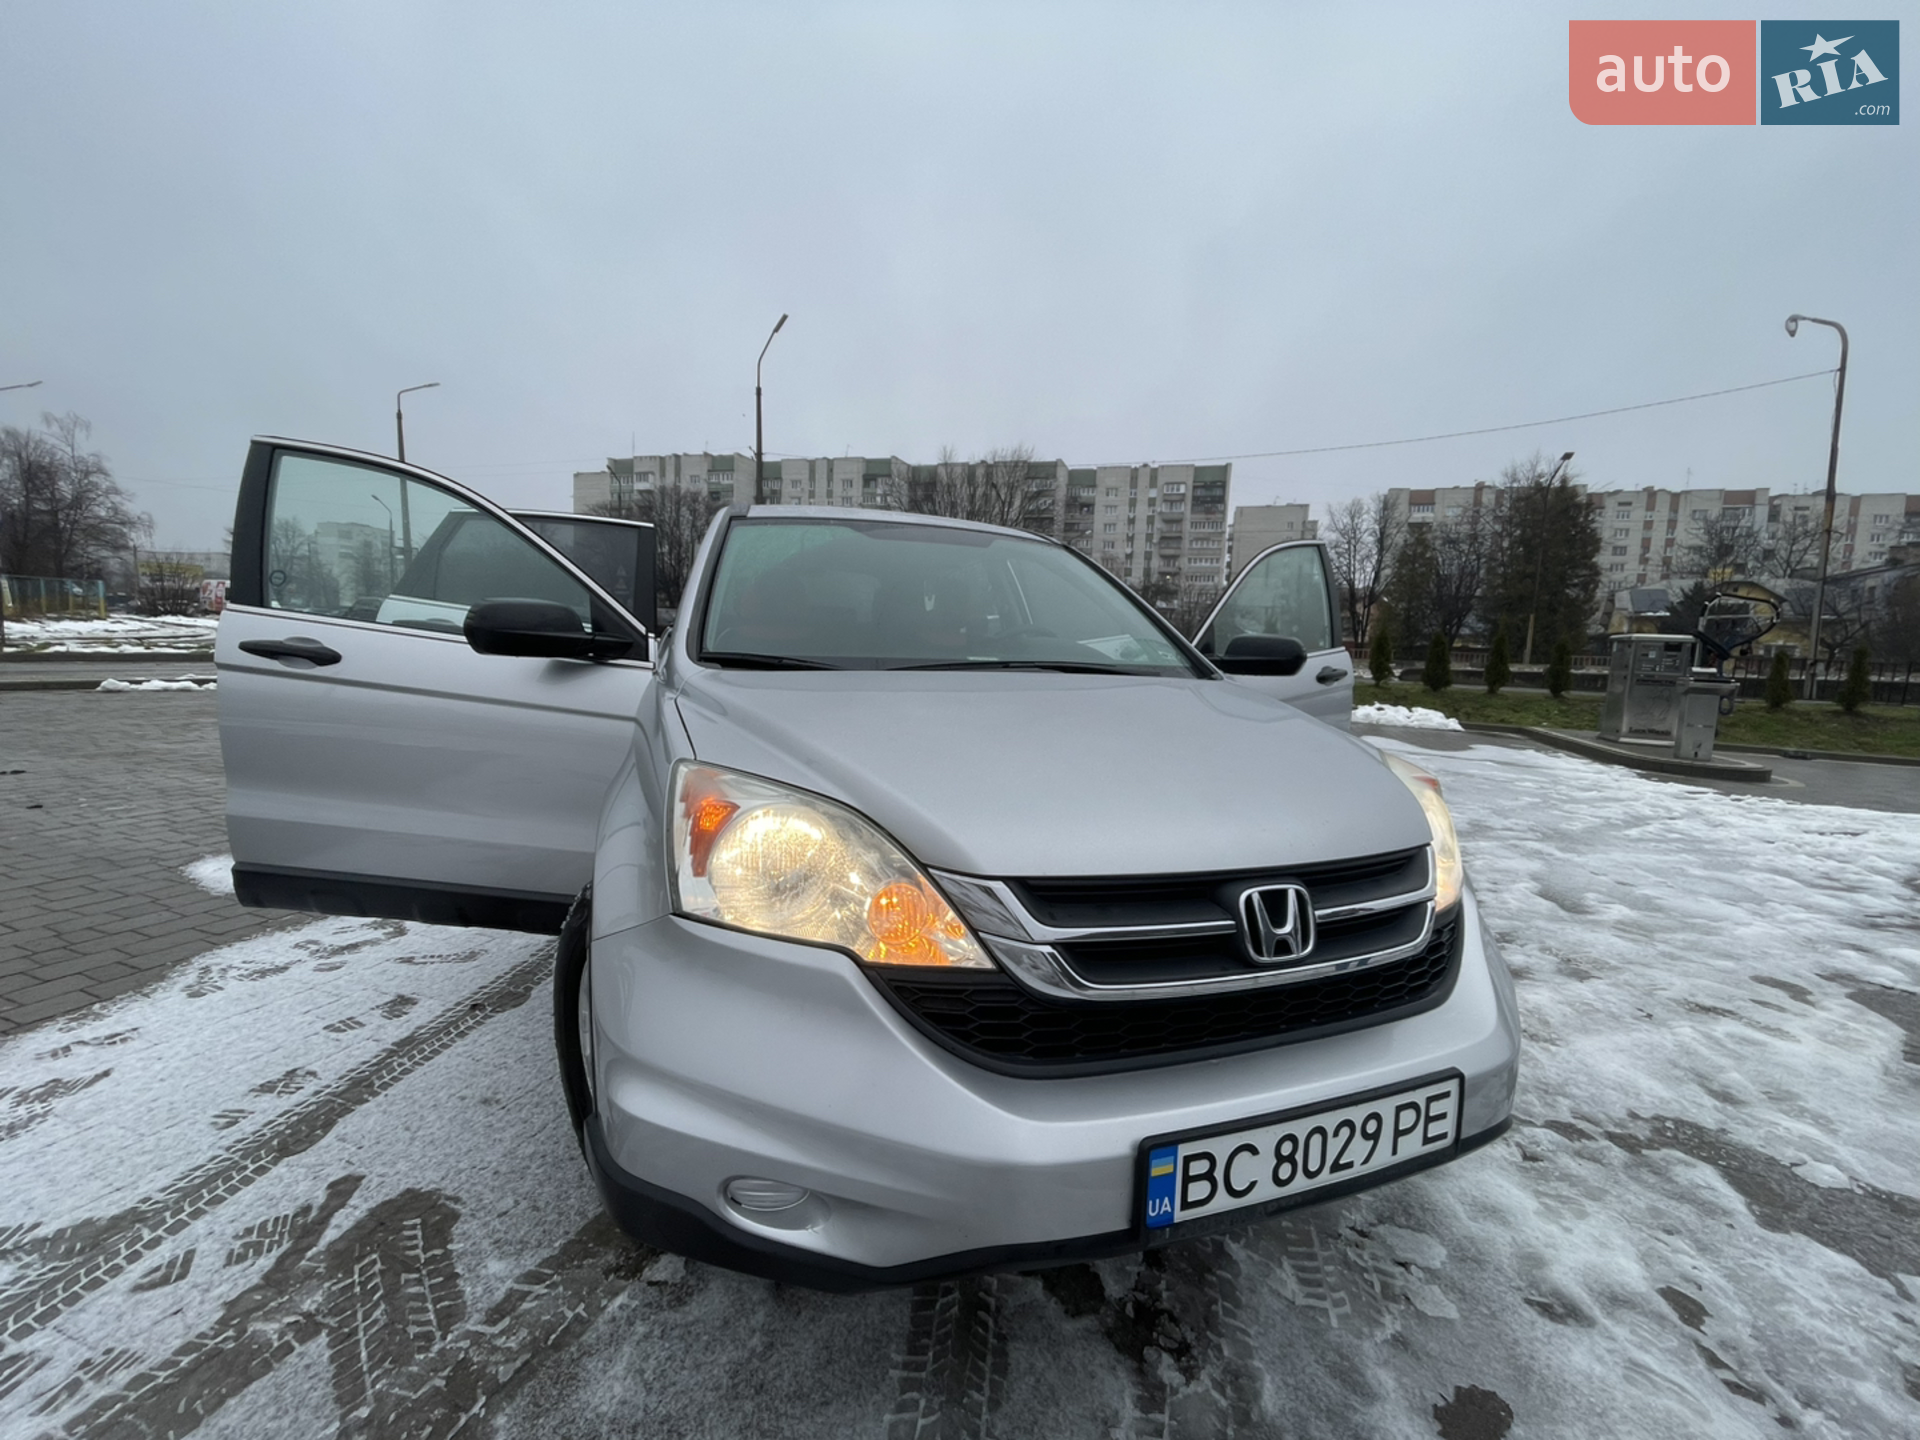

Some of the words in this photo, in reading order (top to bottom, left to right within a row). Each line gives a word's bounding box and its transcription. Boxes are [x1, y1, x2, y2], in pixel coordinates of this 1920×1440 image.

[1180, 1142, 1261, 1213] BC
[1272, 1111, 1384, 1188] 8029
[1391, 1090, 1452, 1157] PE
[1148, 1197, 1172, 1217] UA
